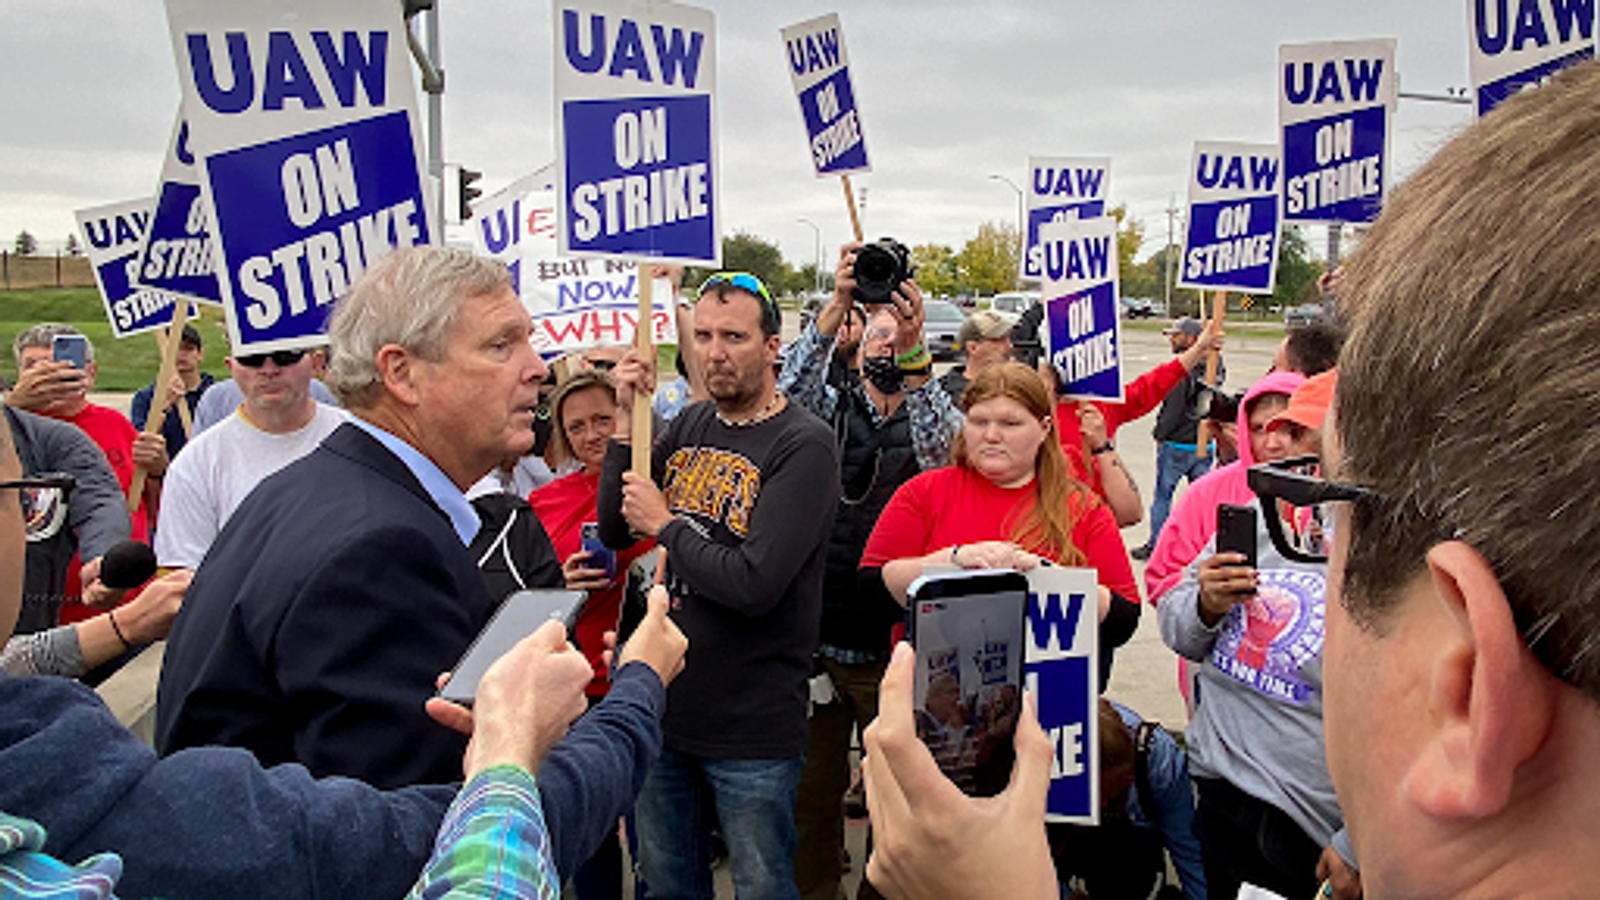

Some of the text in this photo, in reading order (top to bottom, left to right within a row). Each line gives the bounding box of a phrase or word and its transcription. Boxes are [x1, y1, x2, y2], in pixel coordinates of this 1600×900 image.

[562, 8, 704, 88] UAW
[787, 28, 839, 75] UAW
[1474, 0, 1594, 55] UAW
[186, 30, 389, 114] UAW
[1284, 59, 1384, 105] UAW
[816, 81, 841, 123] ON
[613, 106, 668, 170] ON
[812, 109, 861, 168] STRIKE
[1315, 118, 1354, 167] ON
[280, 138, 361, 229] ON
[1033, 167, 1104, 198] UAW
[1197, 153, 1279, 192] UAW
[1287, 153, 1380, 215] STRIKE
[573, 162, 708, 243] STRIKE
[1215, 202, 1251, 240] ON
[144, 238, 217, 280] STRI
[237, 198, 419, 331] STRIKE
[1045, 235, 1110, 283] UAW
[1187, 232, 1273, 280] STRIKE
[1067, 293, 1095, 341] ON
[1053, 328, 1118, 386] STRIKE
